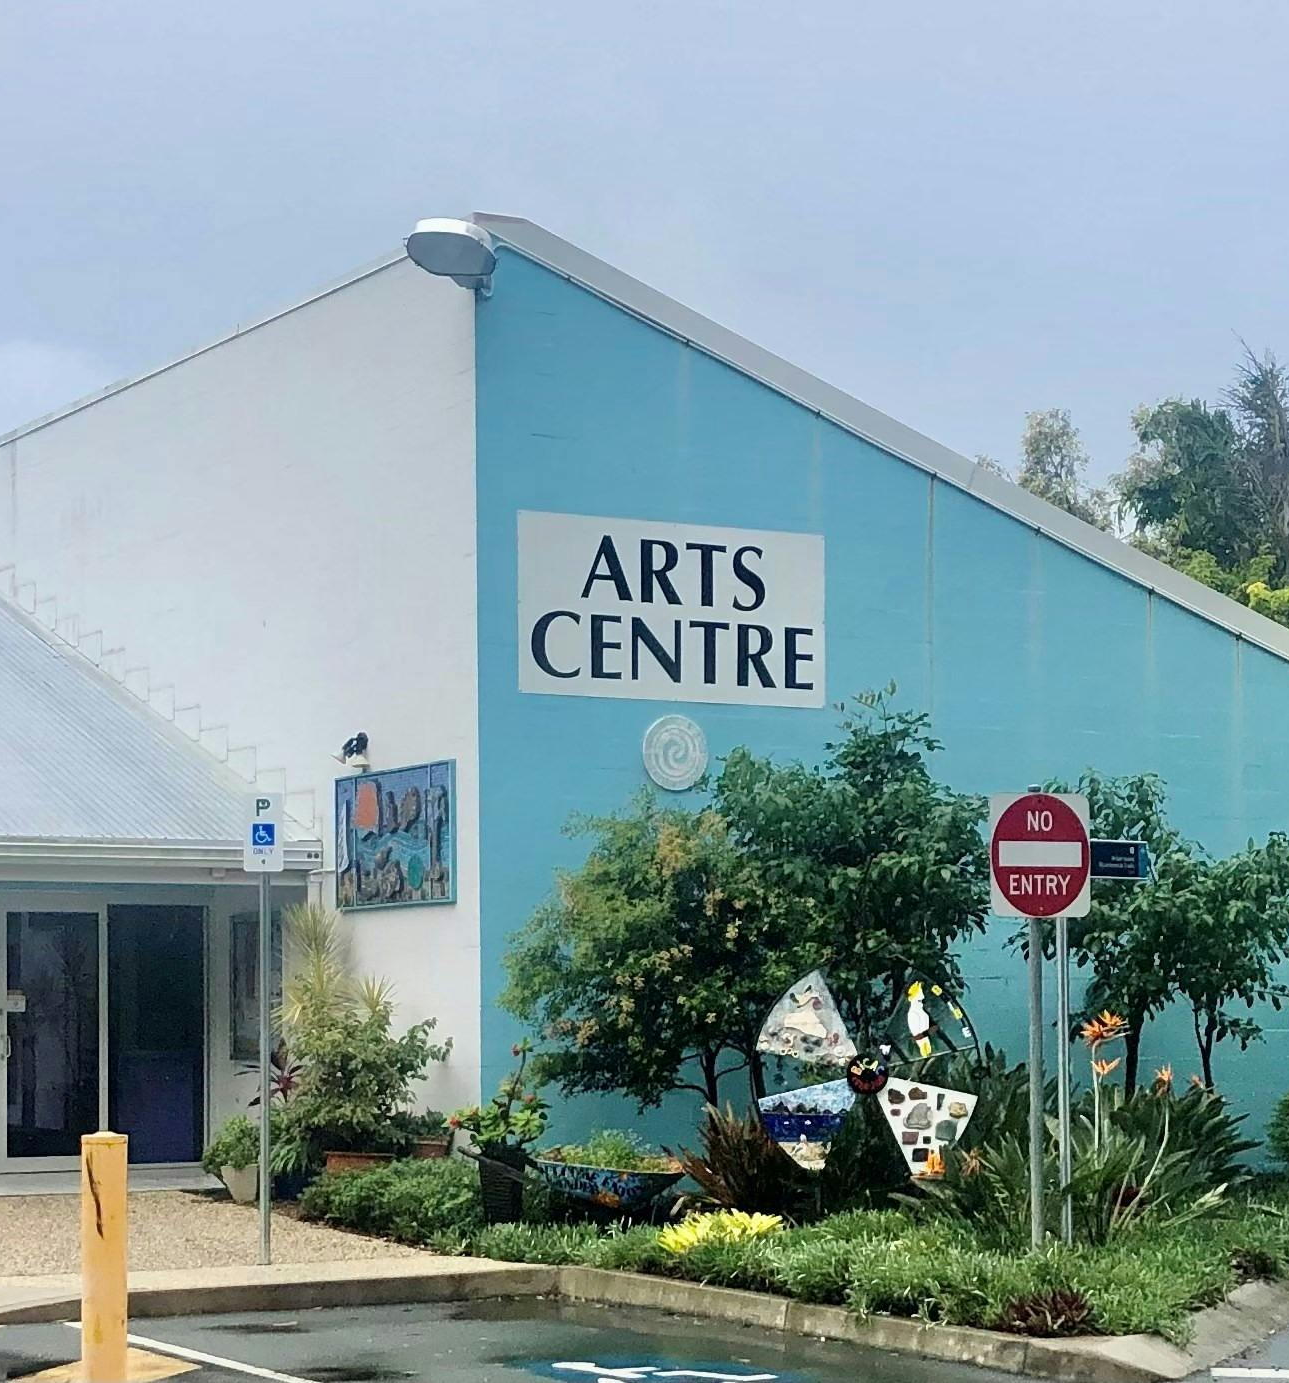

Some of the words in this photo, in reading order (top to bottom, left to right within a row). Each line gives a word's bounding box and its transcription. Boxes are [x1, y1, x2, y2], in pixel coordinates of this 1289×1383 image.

[580, 534, 767, 612] ARTS
[531, 610, 814, 691] CENTRE
[255, 798, 271, 817] P
[1026, 810, 1053, 832] NO
[252, 847, 274, 855] ONLY
[1009, 873, 1071, 896] ENTRY
